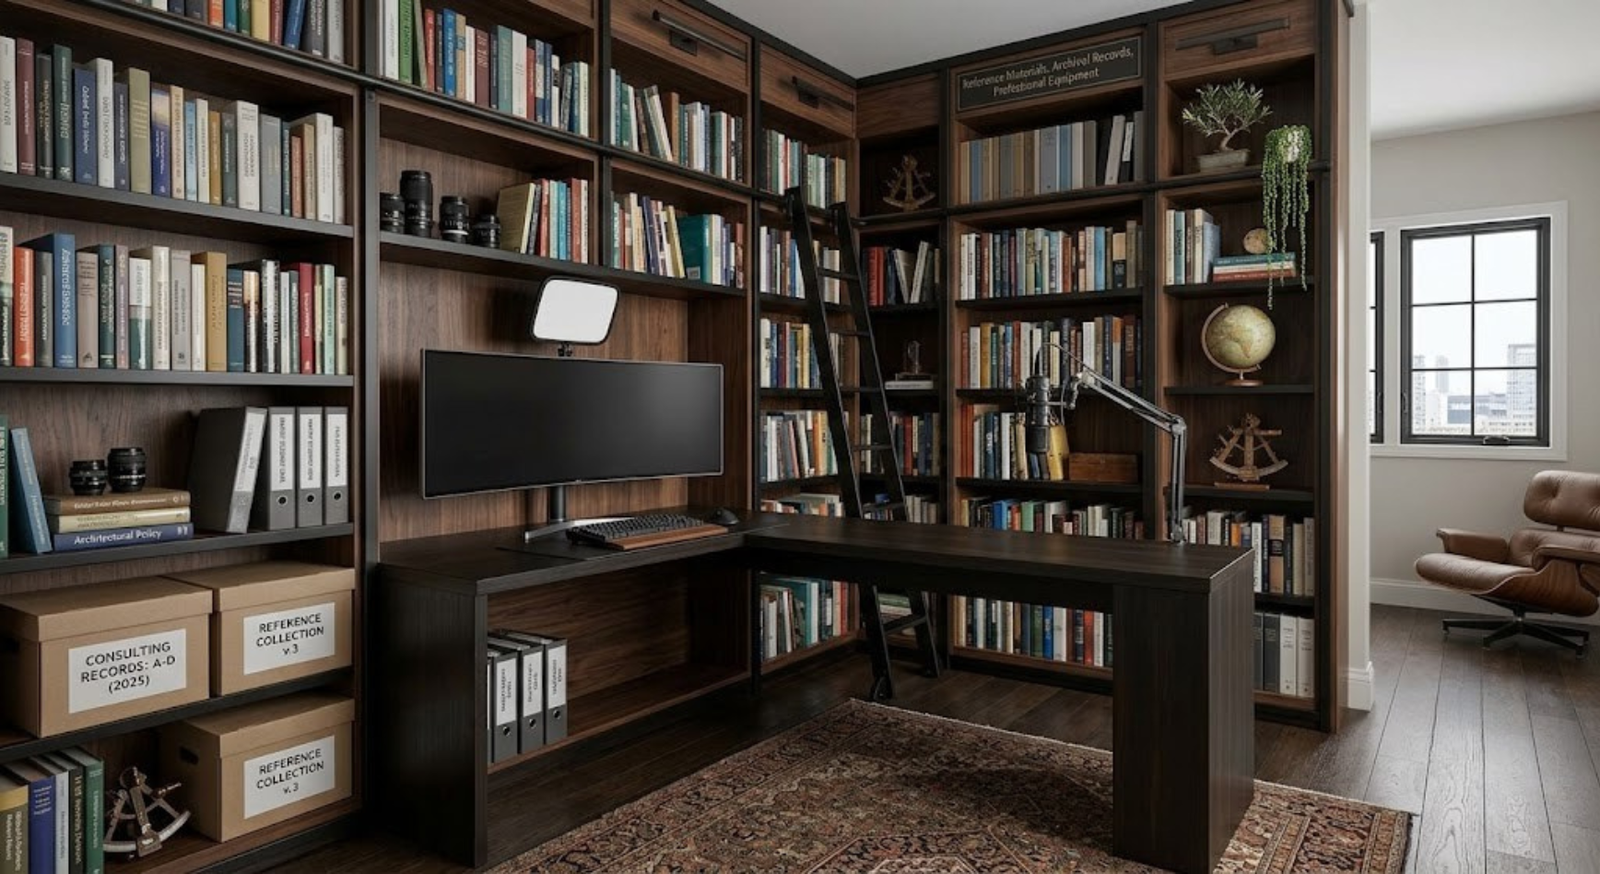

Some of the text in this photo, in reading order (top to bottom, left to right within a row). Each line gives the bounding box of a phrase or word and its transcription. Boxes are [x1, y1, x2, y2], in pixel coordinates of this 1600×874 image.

[1051, 53, 1091, 72] Archival
[256, 626, 324, 647] COLLECTION
[85, 641, 171, 667] CONSULTING
[81, 655, 176, 683] RECORDS: A-D
[108, 675, 150, 694] (2025)
[256, 760, 324, 789] COLLECTION
[259, 748, 322, 775] REFERENCE
